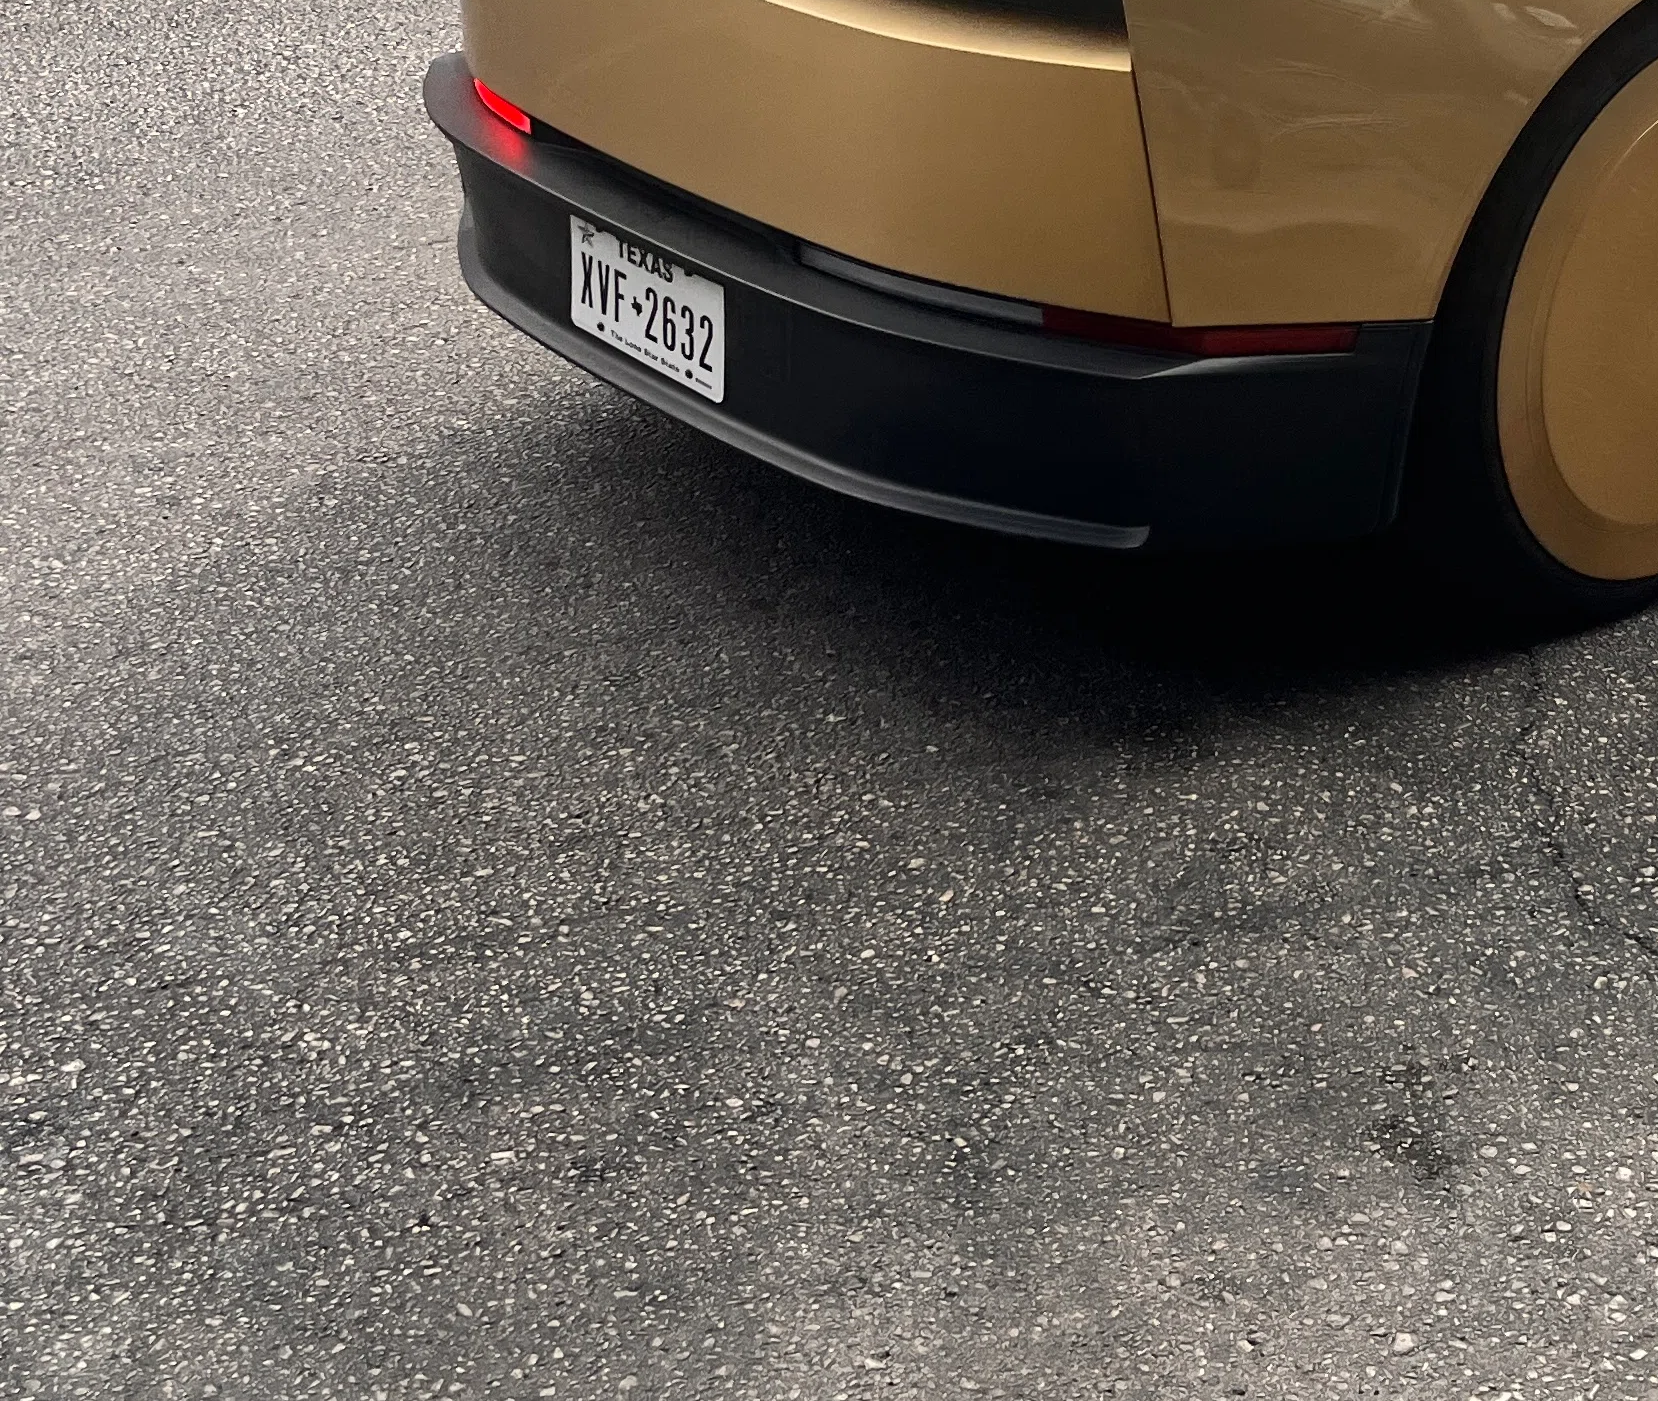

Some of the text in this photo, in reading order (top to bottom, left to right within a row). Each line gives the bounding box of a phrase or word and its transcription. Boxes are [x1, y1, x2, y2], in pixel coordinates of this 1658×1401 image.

[618, 240, 674, 284] TEXAS
[581, 251, 714, 373] XVF 2632
